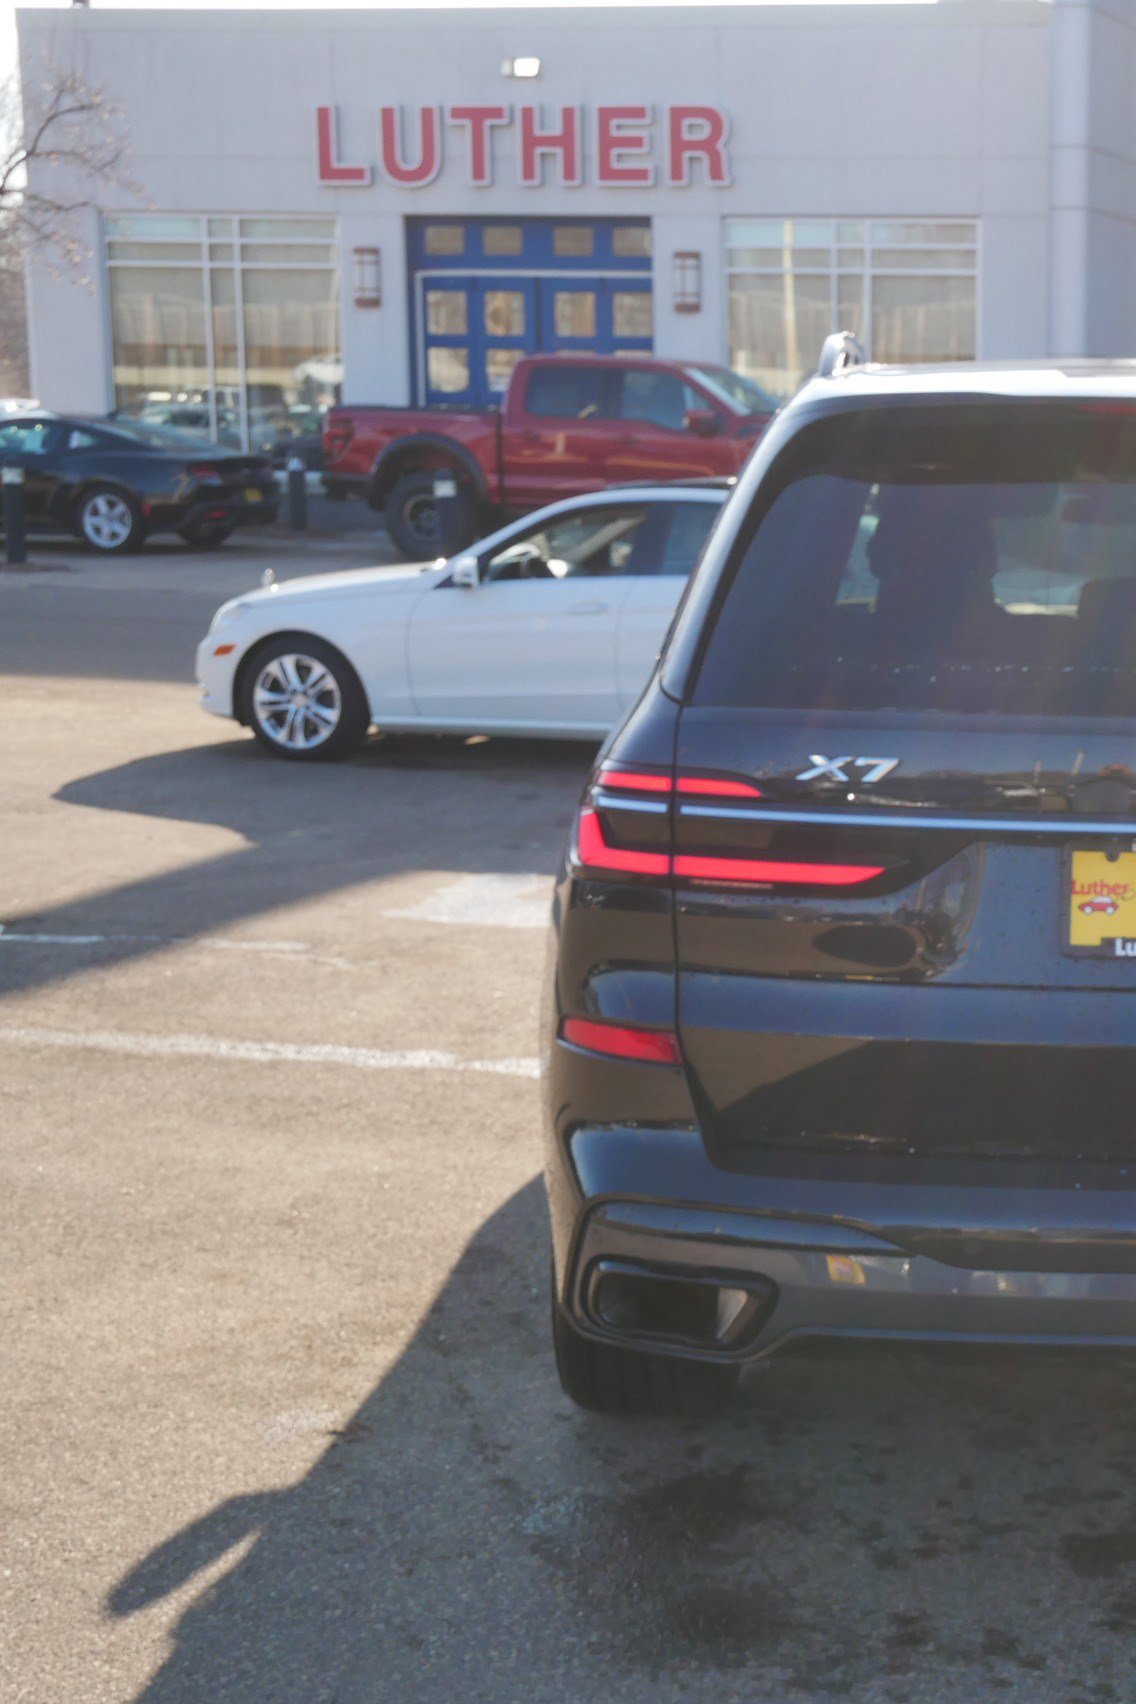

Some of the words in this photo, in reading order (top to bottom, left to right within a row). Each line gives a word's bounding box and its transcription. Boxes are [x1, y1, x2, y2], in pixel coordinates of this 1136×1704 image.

[316, 105, 733, 187] LUTHER
[795, 753, 900, 783] X7
[1071, 879, 1130, 896] Luther
